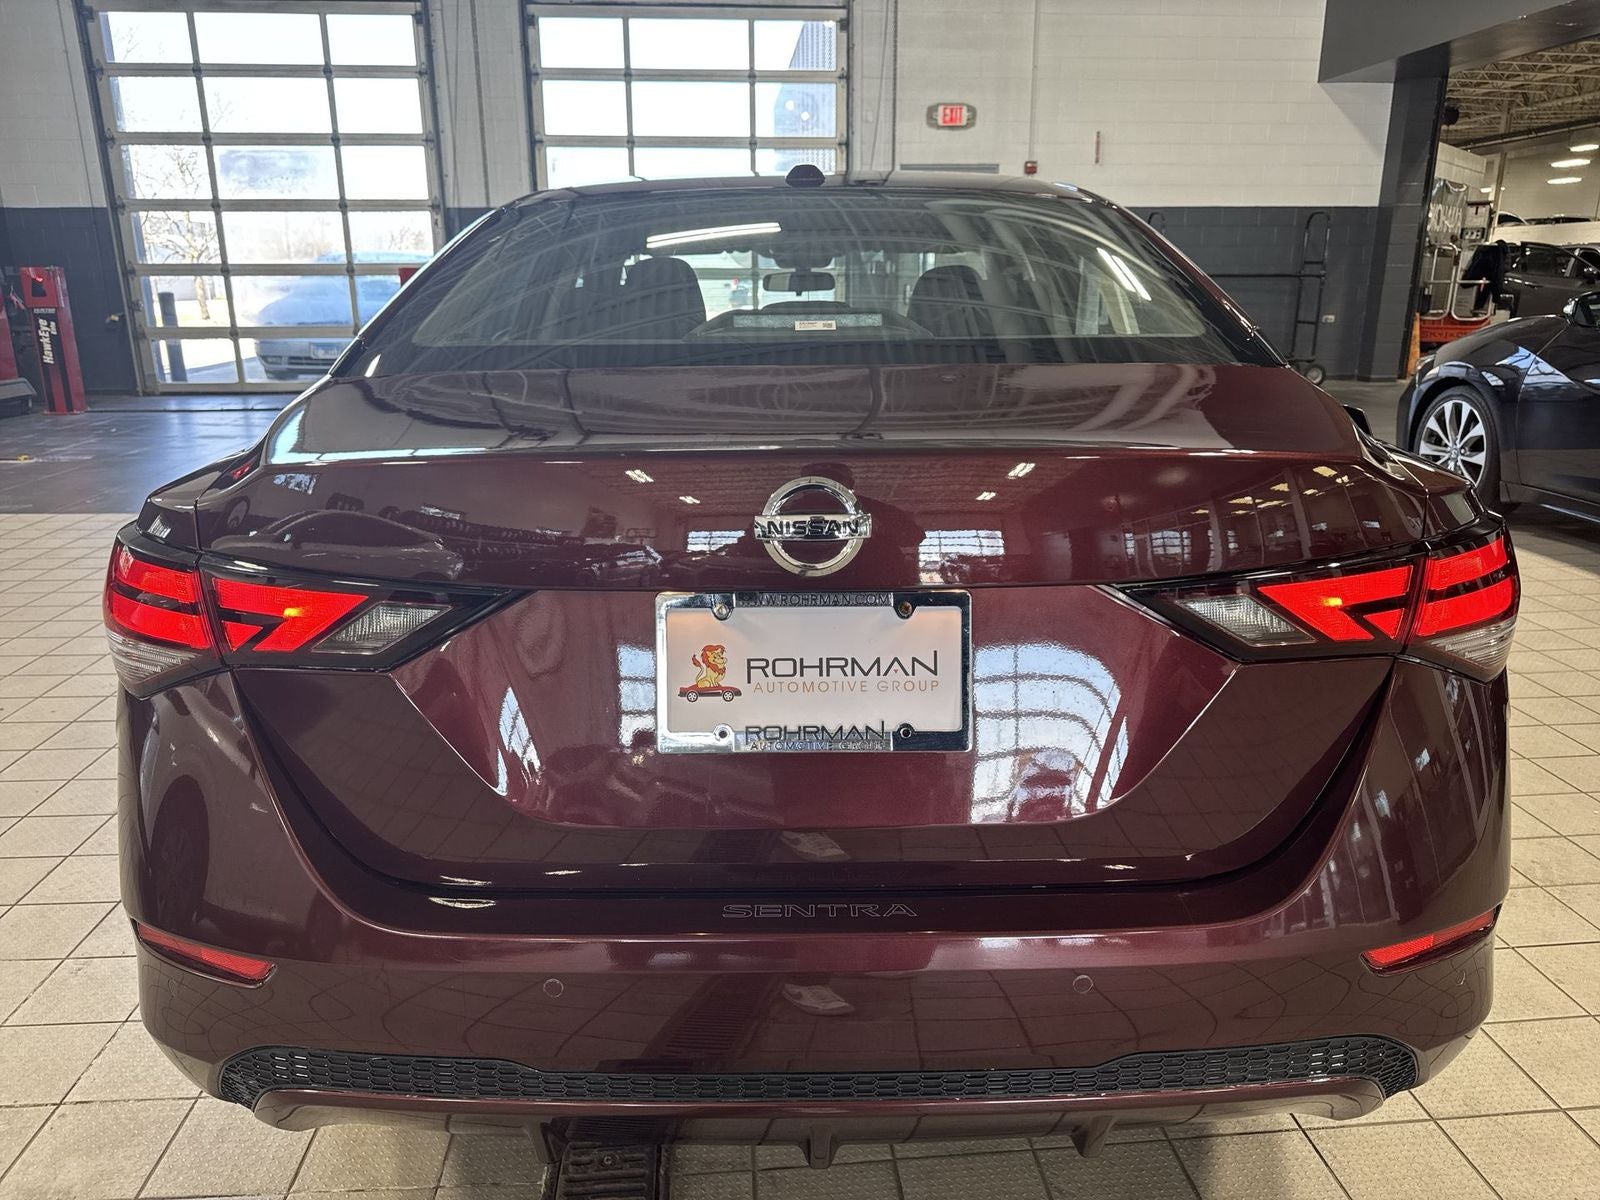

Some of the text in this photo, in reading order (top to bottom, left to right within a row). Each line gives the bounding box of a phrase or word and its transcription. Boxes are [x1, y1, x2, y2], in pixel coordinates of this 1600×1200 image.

[943, 106, 963, 124] EXIT
[38, 318, 55, 364] HawkEye
[766, 519, 859, 536] NISSAN
[746, 650, 937, 684] ROHRMAN
[753, 680, 939, 693] AUTOMOTIVE GROUP
[745, 720, 884, 744] ROHRMAN
[750, 741, 884, 751] AUTOMOTIVE GROUP
[722, 904, 917, 918] SENTRA
